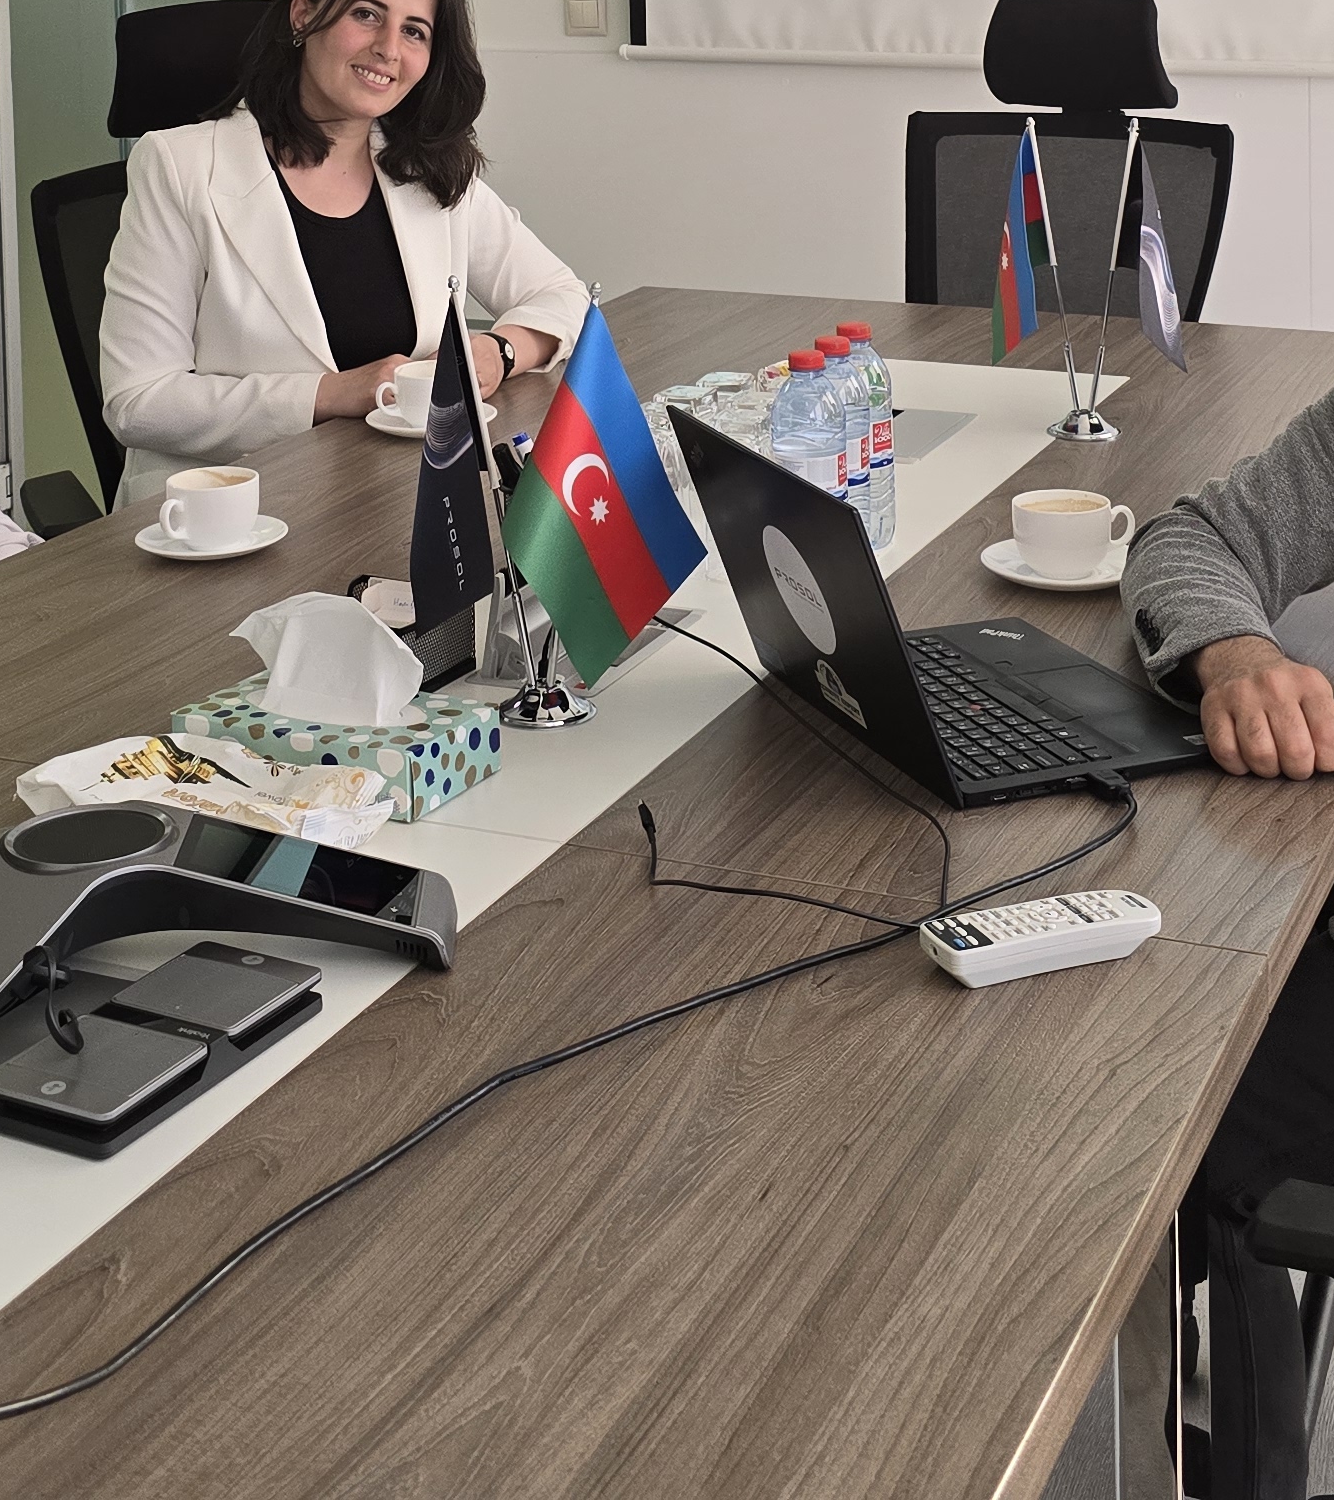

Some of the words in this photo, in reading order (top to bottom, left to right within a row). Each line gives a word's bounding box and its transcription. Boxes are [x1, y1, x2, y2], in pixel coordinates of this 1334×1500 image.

[442, 495, 465, 592] PROSOL
[774, 566, 822, 608] PROSOL
[978, 628, 1025, 641] ThinkPad
